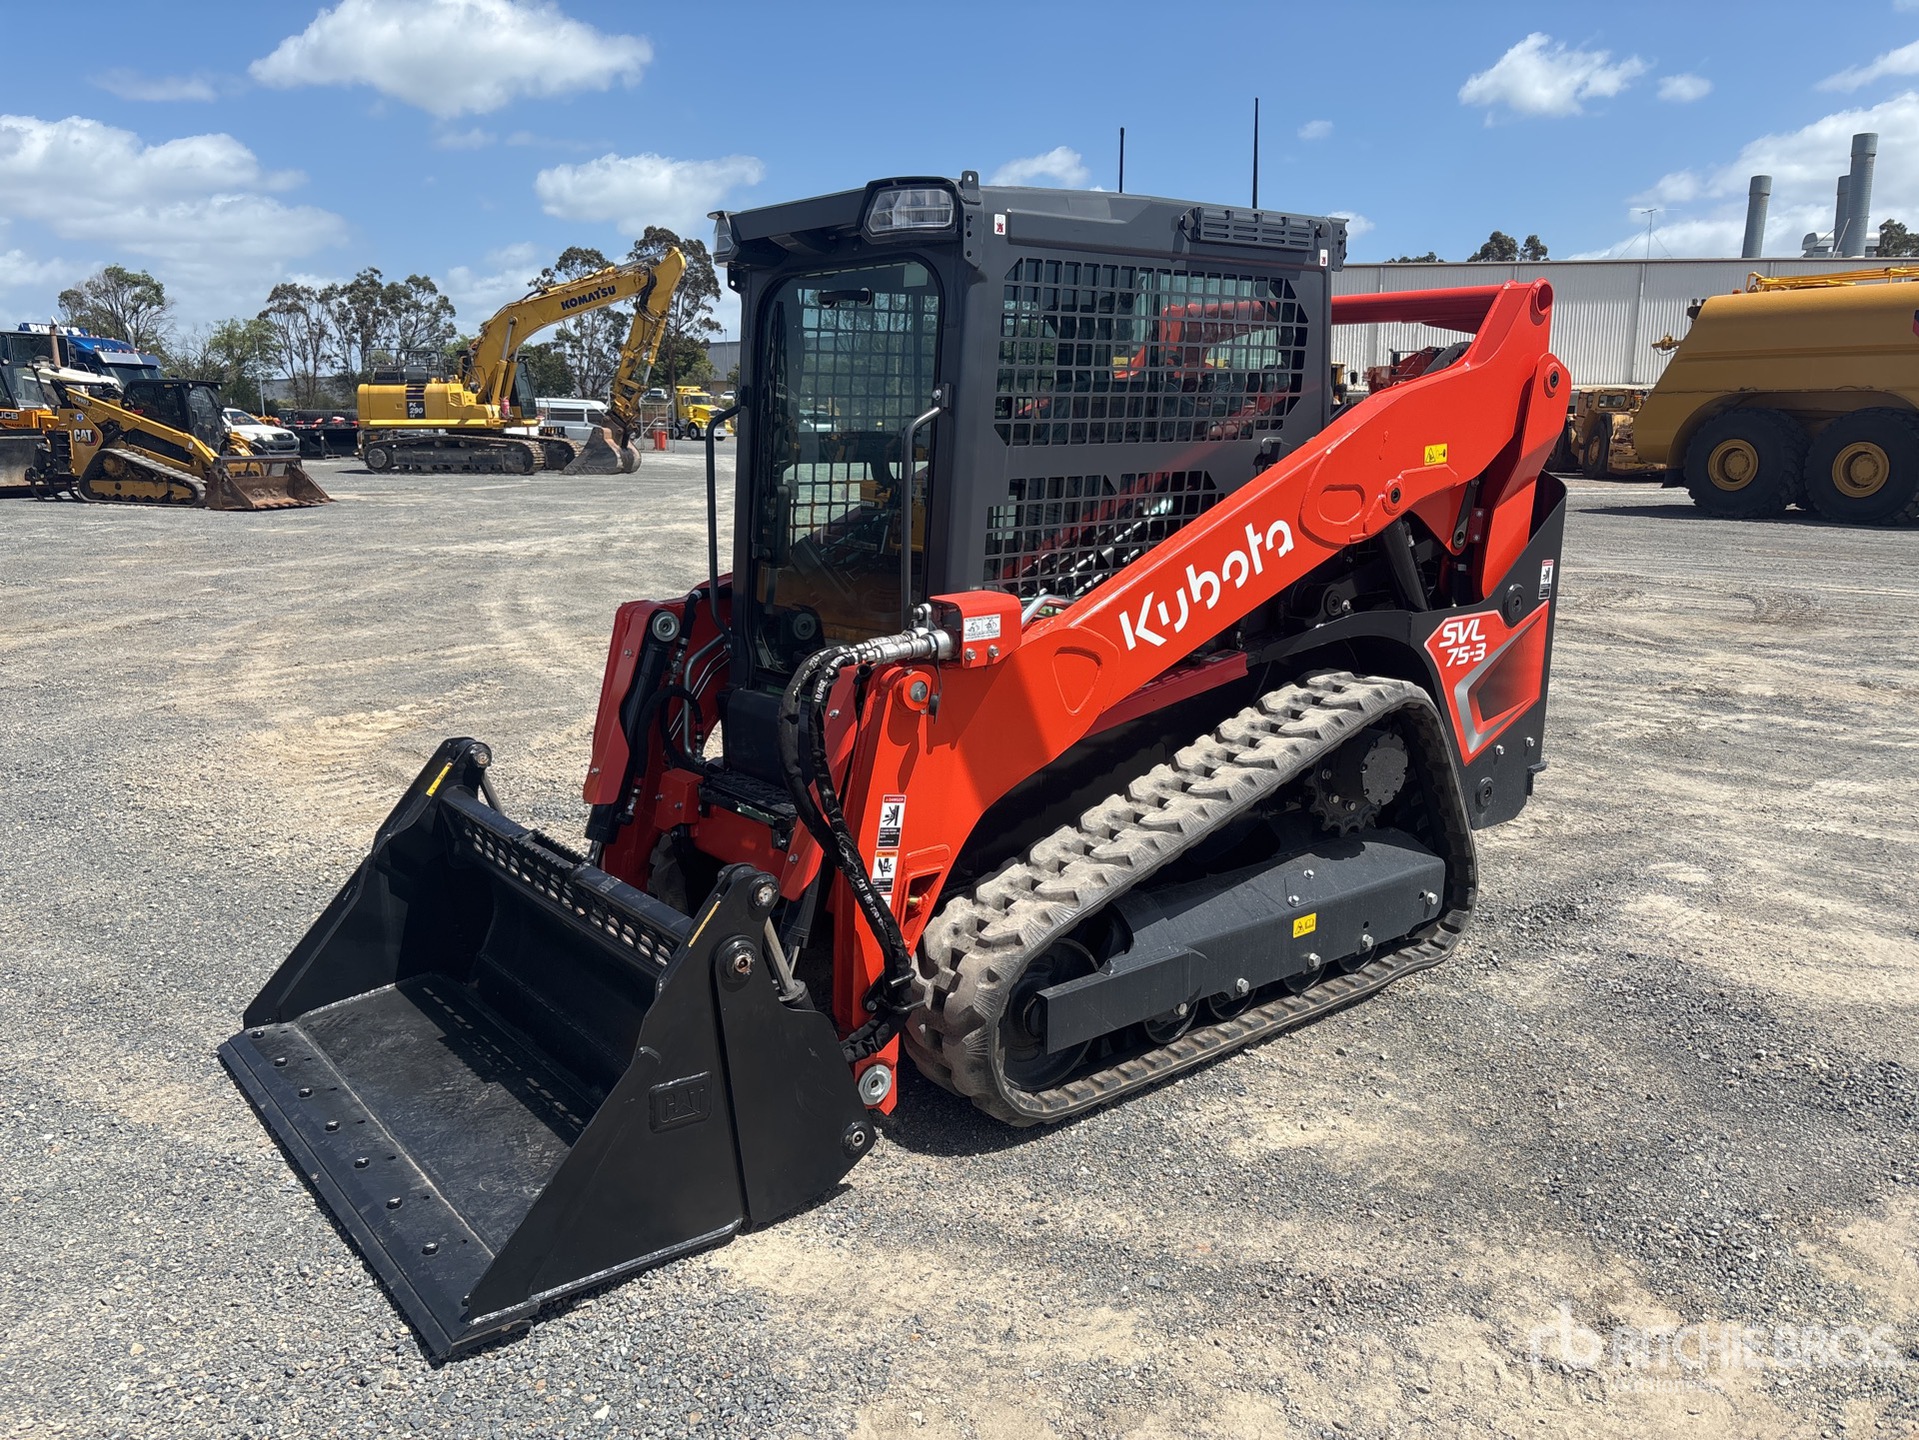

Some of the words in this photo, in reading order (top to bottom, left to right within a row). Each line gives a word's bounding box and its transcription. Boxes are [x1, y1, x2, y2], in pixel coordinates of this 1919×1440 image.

[561, 285, 617, 310] KOMATSU
[29, 323, 81, 336] PINY'S
[0, 411, 19, 420] JCB
[73, 428, 92, 443] CAT
[1118, 519, 1294, 651] Kubota
[1438, 618, 1486, 648] SVL
[1445, 642, 1487, 667] 75-3
[660, 1085, 705, 1123] CAT
